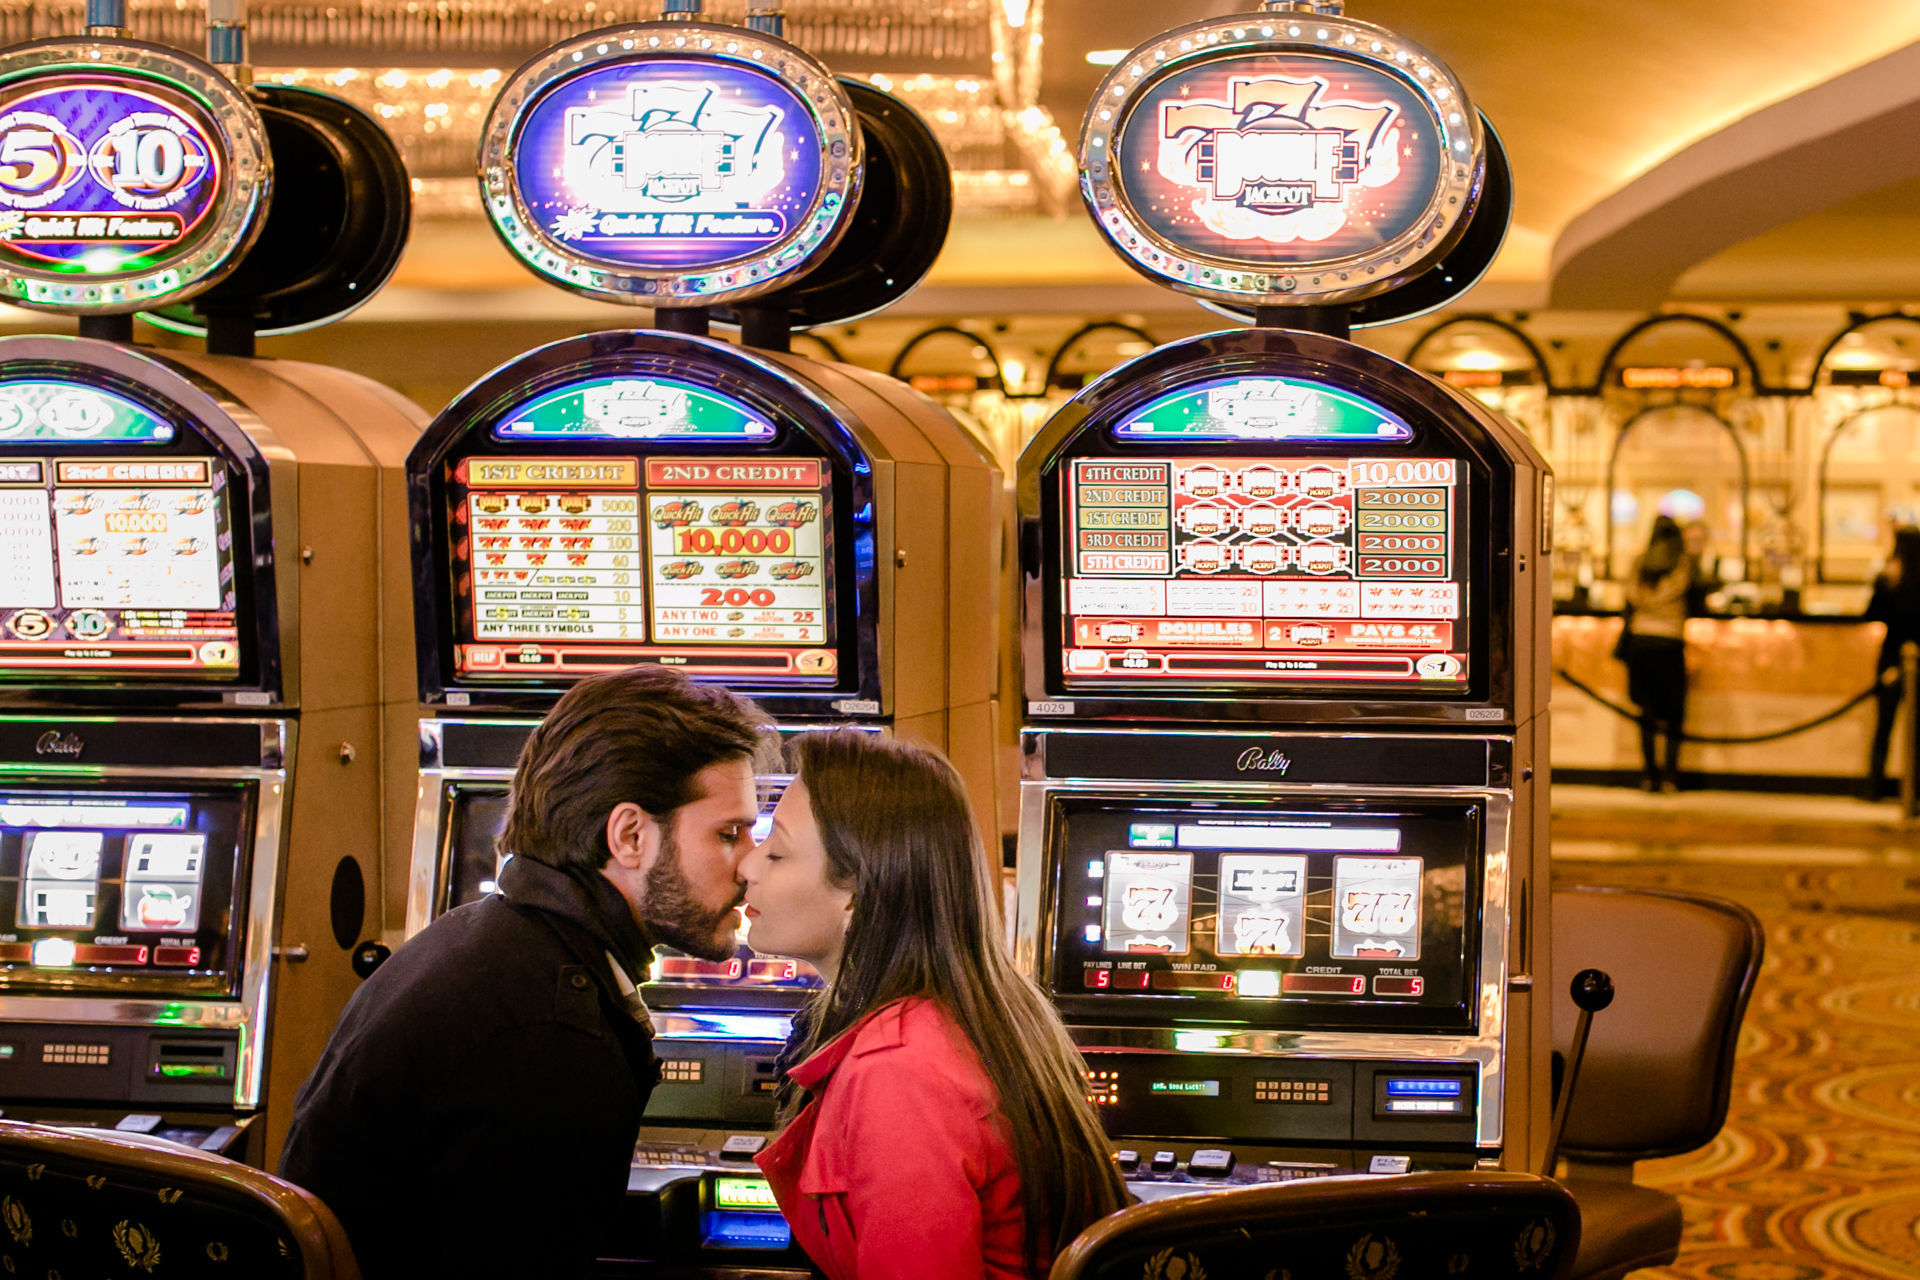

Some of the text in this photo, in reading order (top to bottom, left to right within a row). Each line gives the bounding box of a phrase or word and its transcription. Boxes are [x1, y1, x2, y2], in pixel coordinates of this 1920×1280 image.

[0, 129, 184, 191] 5 10
[1244, 186, 1312, 206] JACKPOT
[66, 465, 199, 480] 2nd CREDIT
[481, 465, 623, 480] 1ST CREDIT
[662, 466, 806, 481] 2ND CREDIT
[1085, 467, 1163, 481] 4TH CREDIT
[1353, 461, 1450, 487] 10,000
[1085, 489, 1164, 503] 2ND CREDIT
[1363, 492, 1440, 505] 2000
[602, 500, 635, 513] 5000
[653, 505, 704, 521] Quick Hit
[709, 505, 760, 521] Quick Hit
[766, 505, 818, 522] Quick Hit
[1087, 512, 1161, 525] 1ST CREDIT
[606, 519, 632, 532] 200
[1363, 514, 1440, 528] 2000
[607, 537, 633, 550] 100
[678, 528, 791, 556] 10,000
[1087, 534, 1164, 547] 3RD CREDIT
[1364, 537, 1440, 550] 2000
[612, 555, 629, 567] 40
[1087, 555, 1164, 569] 5TH CREDIT
[1364, 559, 1440, 573] 2000
[612, 572, 630, 585] 20
[485, 590, 631, 603] JACKPOT JACKPOT JACKPOT 10
[700, 588, 776, 606] 200
[1241, 586, 1258, 597] 20
[1429, 588, 1453, 599] 200
[618, 607, 627, 620] 5
[1241, 602, 1257, 613] 10
[1429, 604, 1452, 615] 100
[662, 611, 688, 621] ANY
[691, 611, 719, 621] TWO
[793, 611, 814, 623] 25
[16, 614, 48, 635] 5
[74, 614, 106, 636] 10
[482, 624, 628, 637] ANY THREE SYMBOLS 2
[1157, 621, 1253, 635] DOUBLES
[1350, 623, 1438, 637] PAYS 4X
[663, 627, 689, 637] ANY
[693, 627, 718, 637] ONE
[798, 628, 810, 640] 2
[1268, 627, 1281, 641] 2
[473, 653, 496, 663] HELP
[1036, 703, 1065, 713] 4029
[1469, 710, 1502, 719] 026205
[1236, 746, 1291, 776] Bally
[94, 936, 129, 945] CREDIT
[160, 937, 180, 946] TOTAL
[729, 961, 740, 976] 0
[783, 963, 794, 978] 2
[1083, 961, 1113, 969] PAY LINES
[1117, 962, 1147, 970] LINE BET
[1172, 963, 1217, 971] WIN PAID
[1305, 966, 1343, 974] CREDIT
[1097, 971, 1109, 987] 5
[1141, 972, 1149, 987] 1
[1222, 974, 1234, 989] 0
[1352, 977, 1364, 993] 0
[1410, 979, 1421, 994] 5
